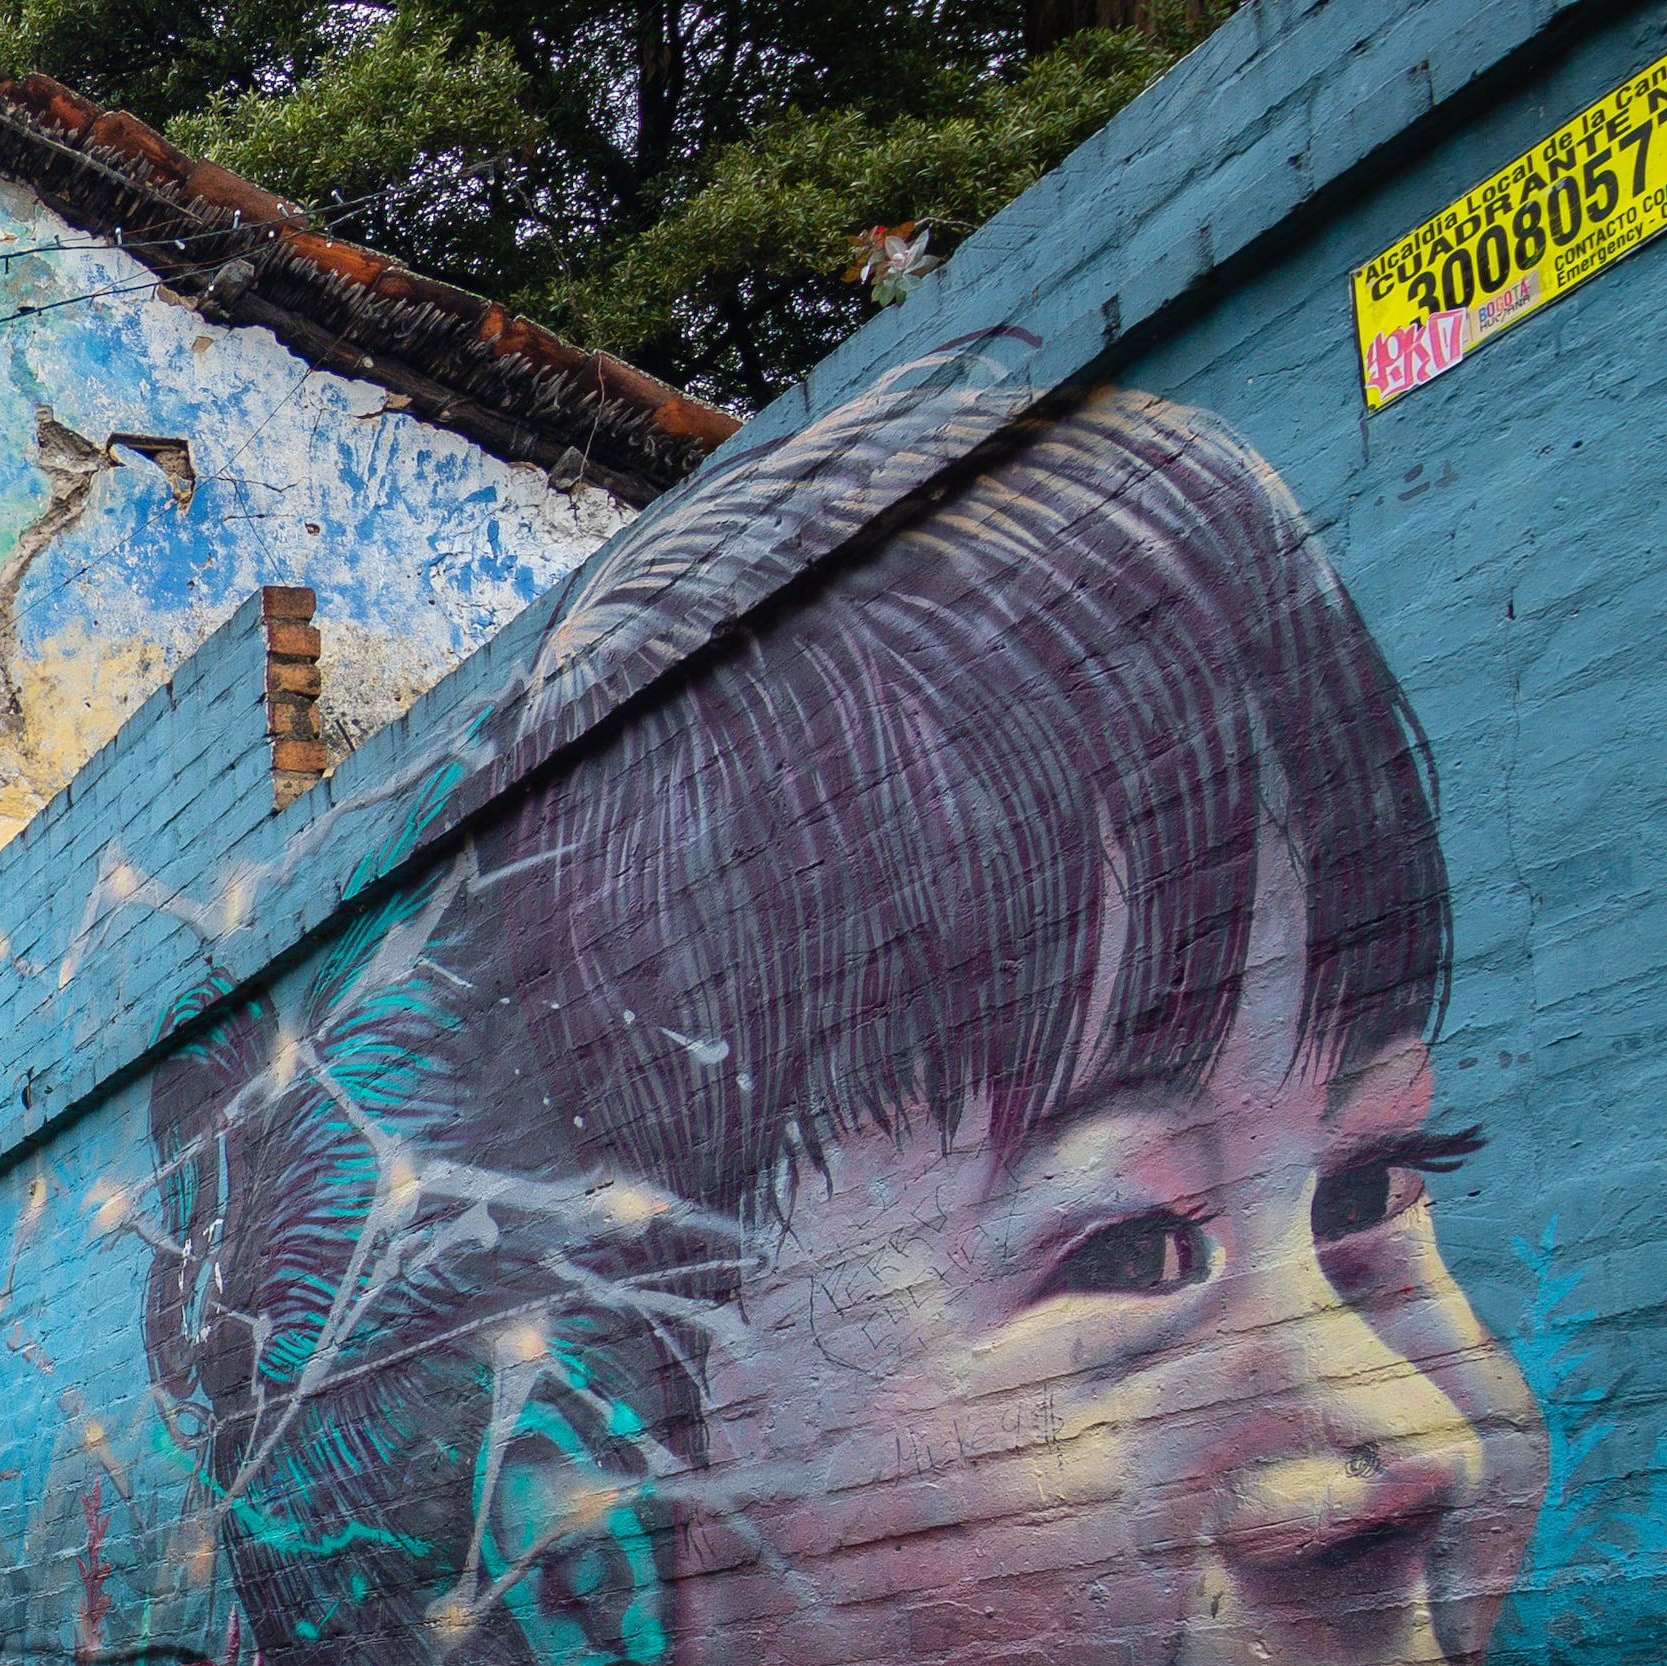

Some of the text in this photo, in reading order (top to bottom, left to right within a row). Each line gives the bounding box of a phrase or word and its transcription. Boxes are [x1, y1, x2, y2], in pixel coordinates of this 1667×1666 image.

[1365, 211, 1458, 284] Alcaldia
[1467, 157, 1535, 215] Local
[1543, 131, 1574, 161] de
[1582, 109, 1606, 133] la
[1370, 107, 1634, 302] CUADRANTE
[1408, 111, 1667, 331] 3008057
[1555, 206, 1637, 272] CONTACTO
[1557, 222, 1643, 288] Emergency
